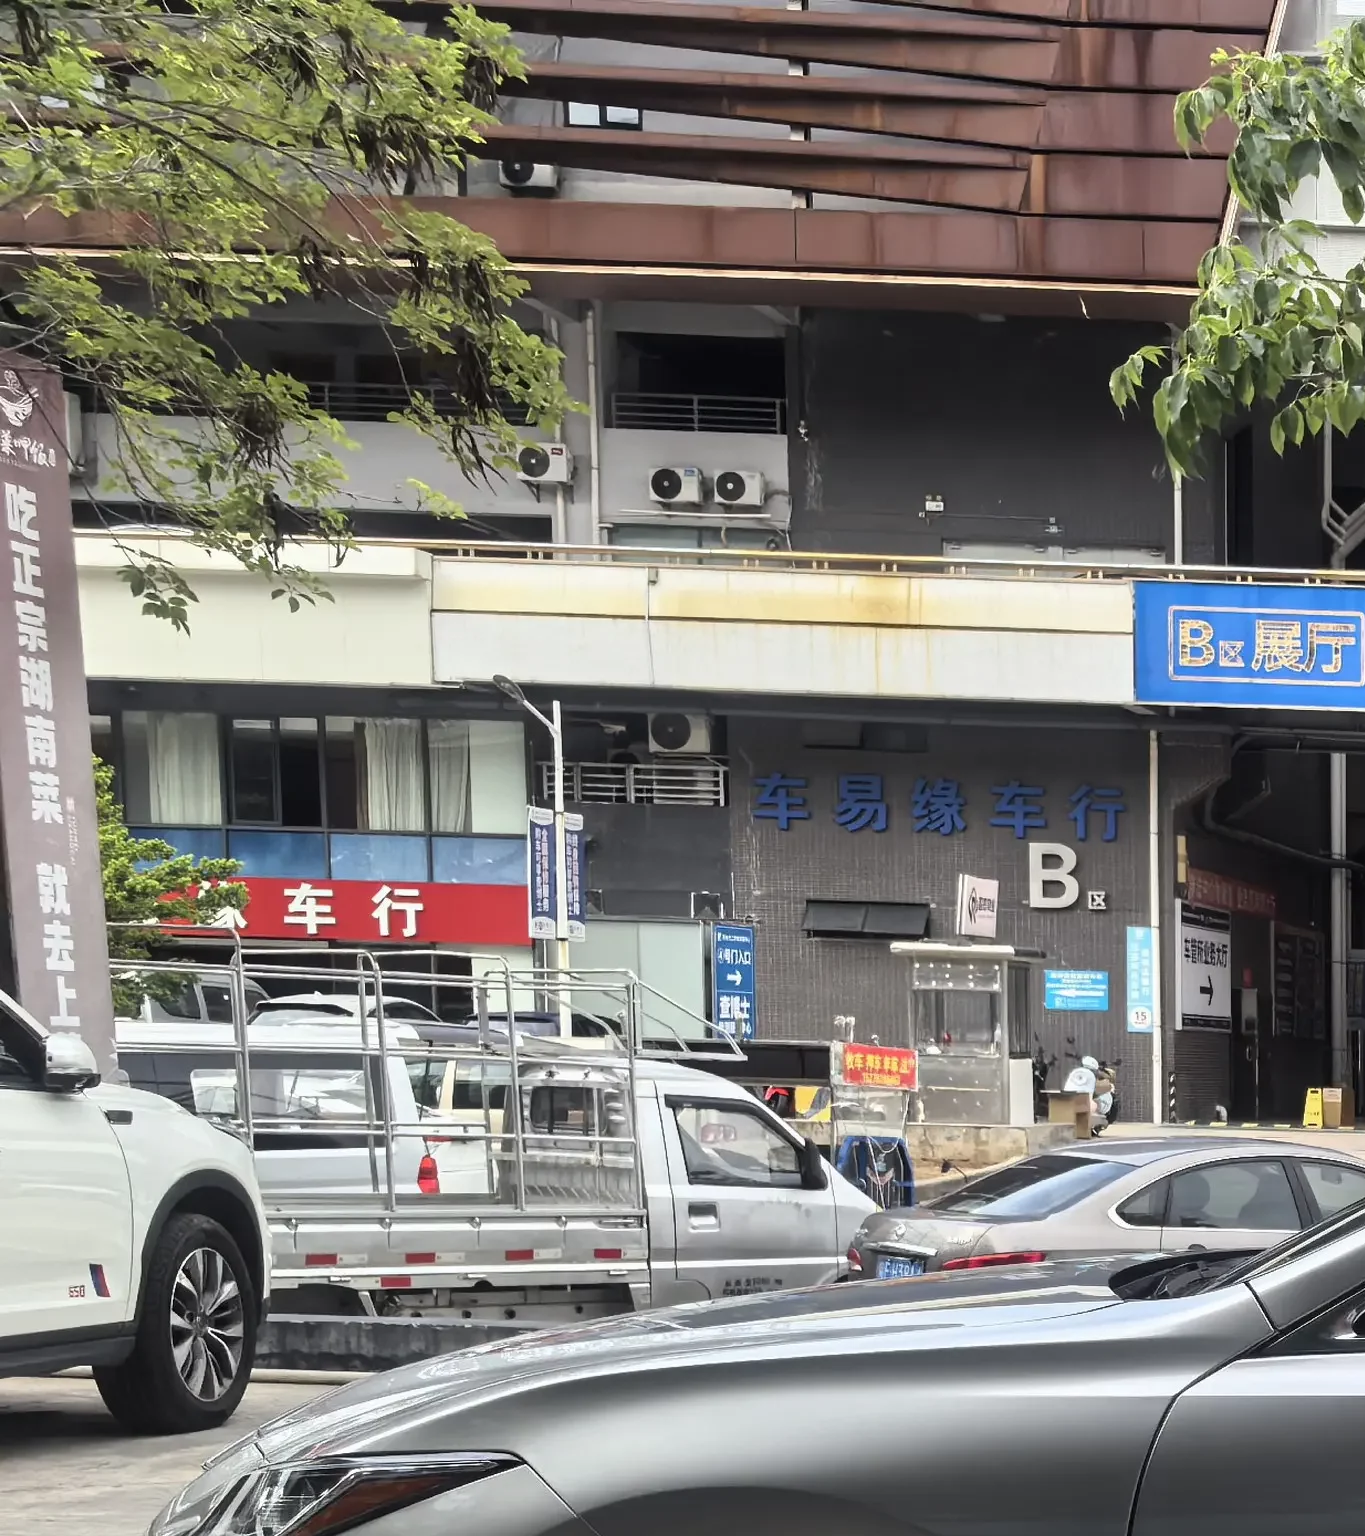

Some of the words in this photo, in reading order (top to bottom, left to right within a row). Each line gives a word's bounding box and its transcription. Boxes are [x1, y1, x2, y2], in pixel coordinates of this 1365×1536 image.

[1179, 618, 1357, 673] B区展厅
[5, 482, 63, 825] 吃正宗湖南菜
[36, 862, 81, 1041] 就去上
[752, 772, 1126, 841] 车易缘车行
[1028, 842, 1106, 911] B区
